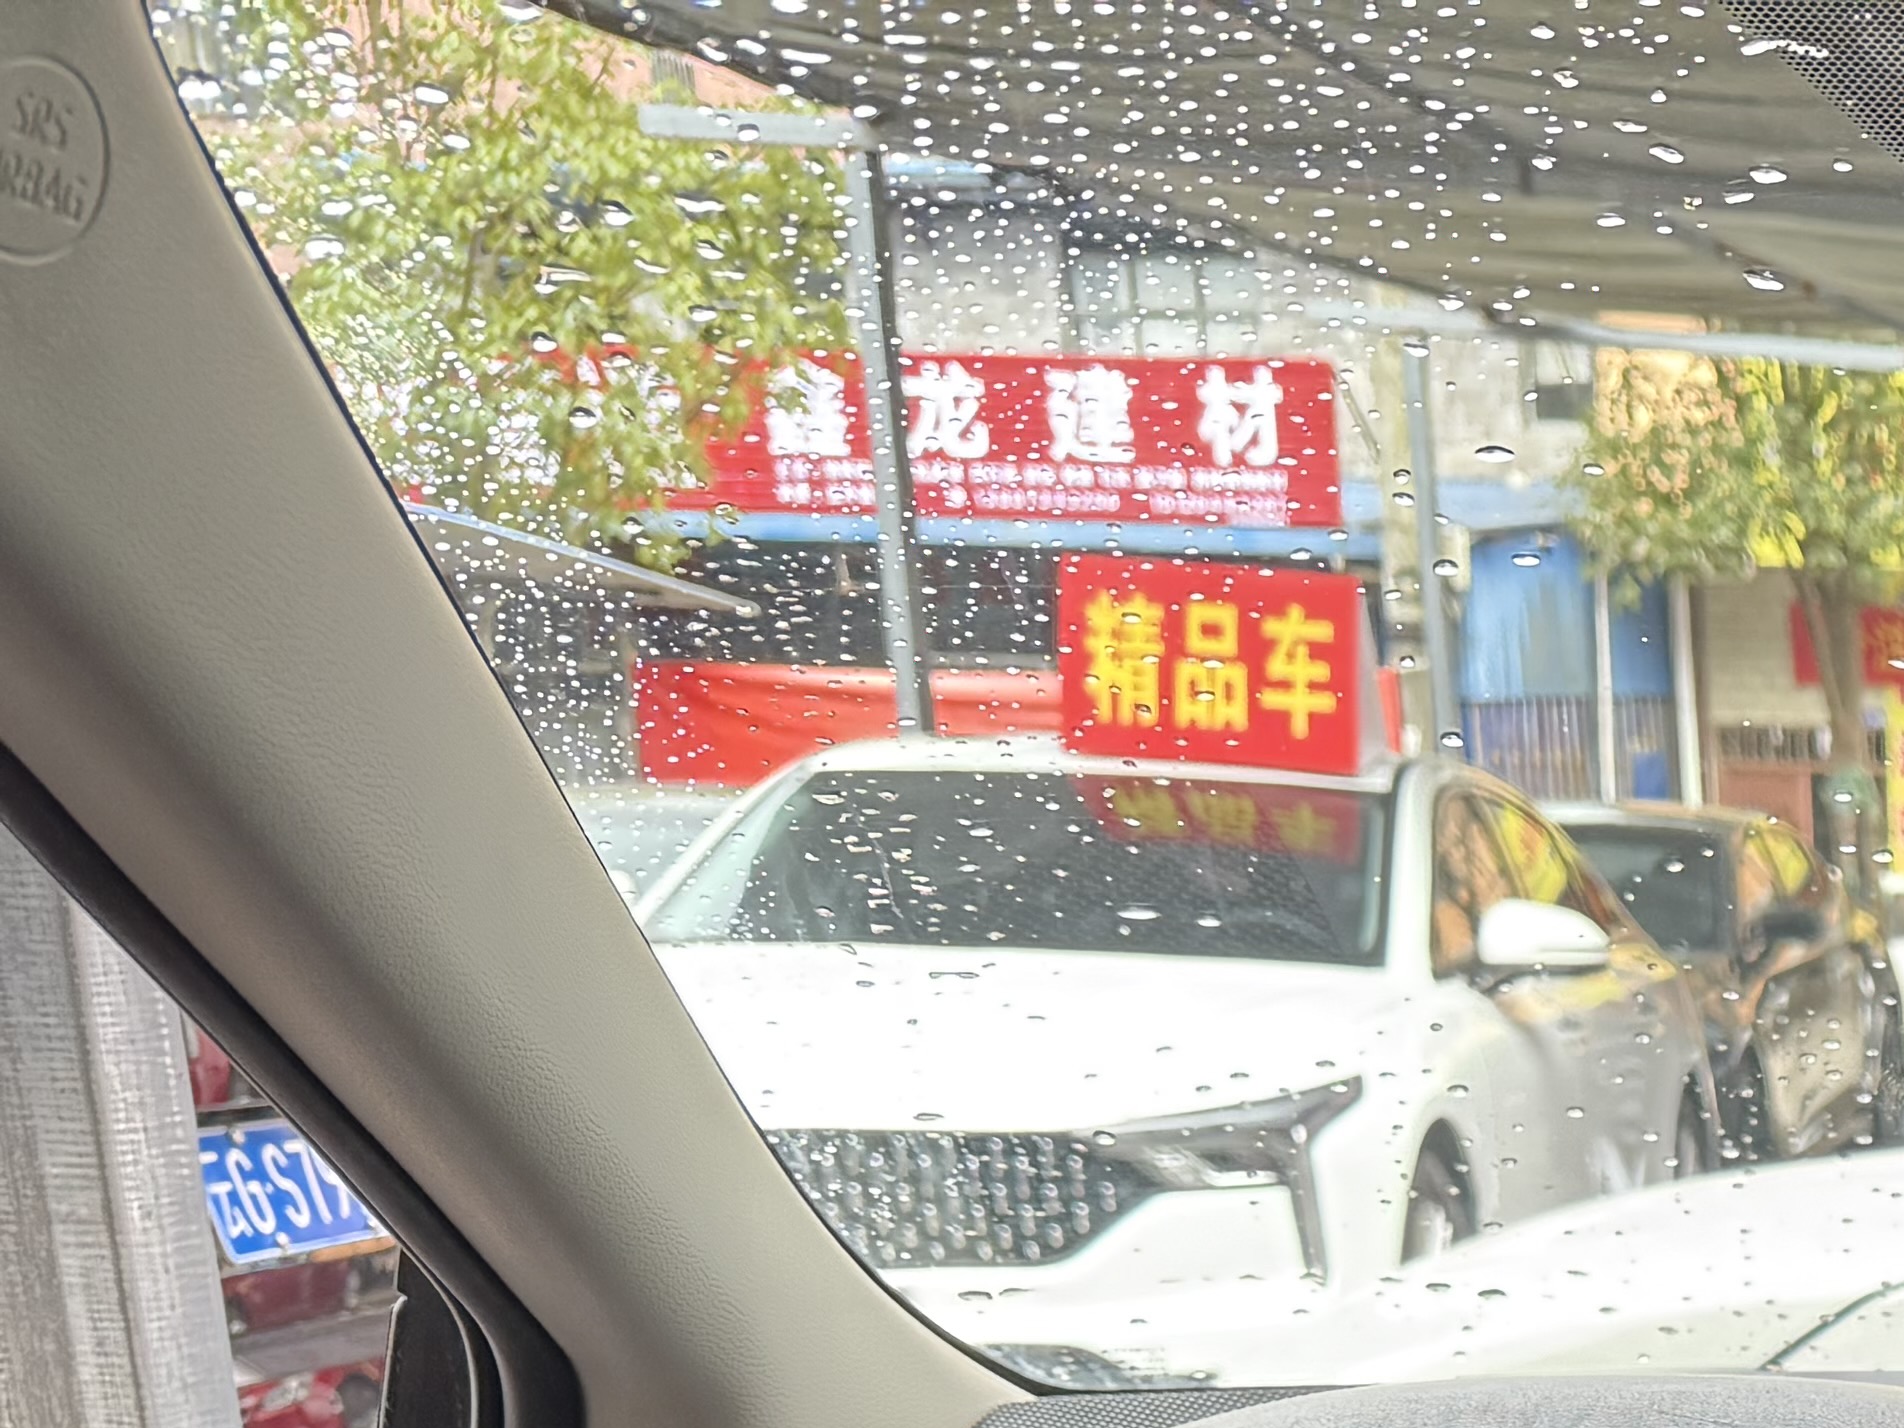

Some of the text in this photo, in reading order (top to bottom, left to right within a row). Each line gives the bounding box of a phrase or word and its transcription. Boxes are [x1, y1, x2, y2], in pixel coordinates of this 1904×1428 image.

[10, 92, 74, 151] SRS
[1084, 592, 1337, 739] 精品车
